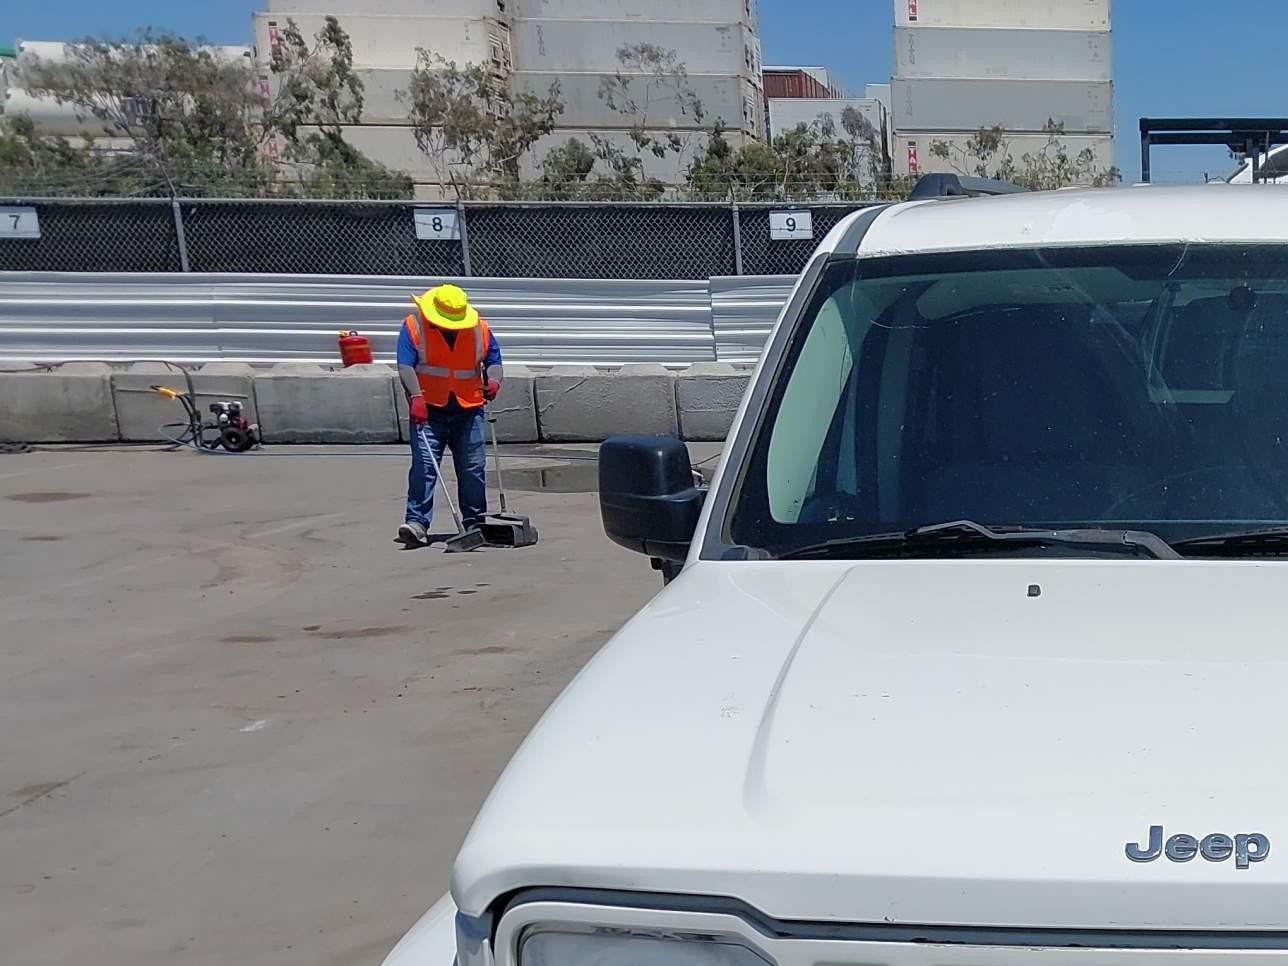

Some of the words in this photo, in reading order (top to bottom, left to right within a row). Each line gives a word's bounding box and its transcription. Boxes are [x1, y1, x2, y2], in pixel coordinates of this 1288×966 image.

[8, 214, 20, 229] 7
[432, 216, 443, 232] 8
[785, 217, 796, 232] 9
[1125, 825, 1271, 869] Jeep
